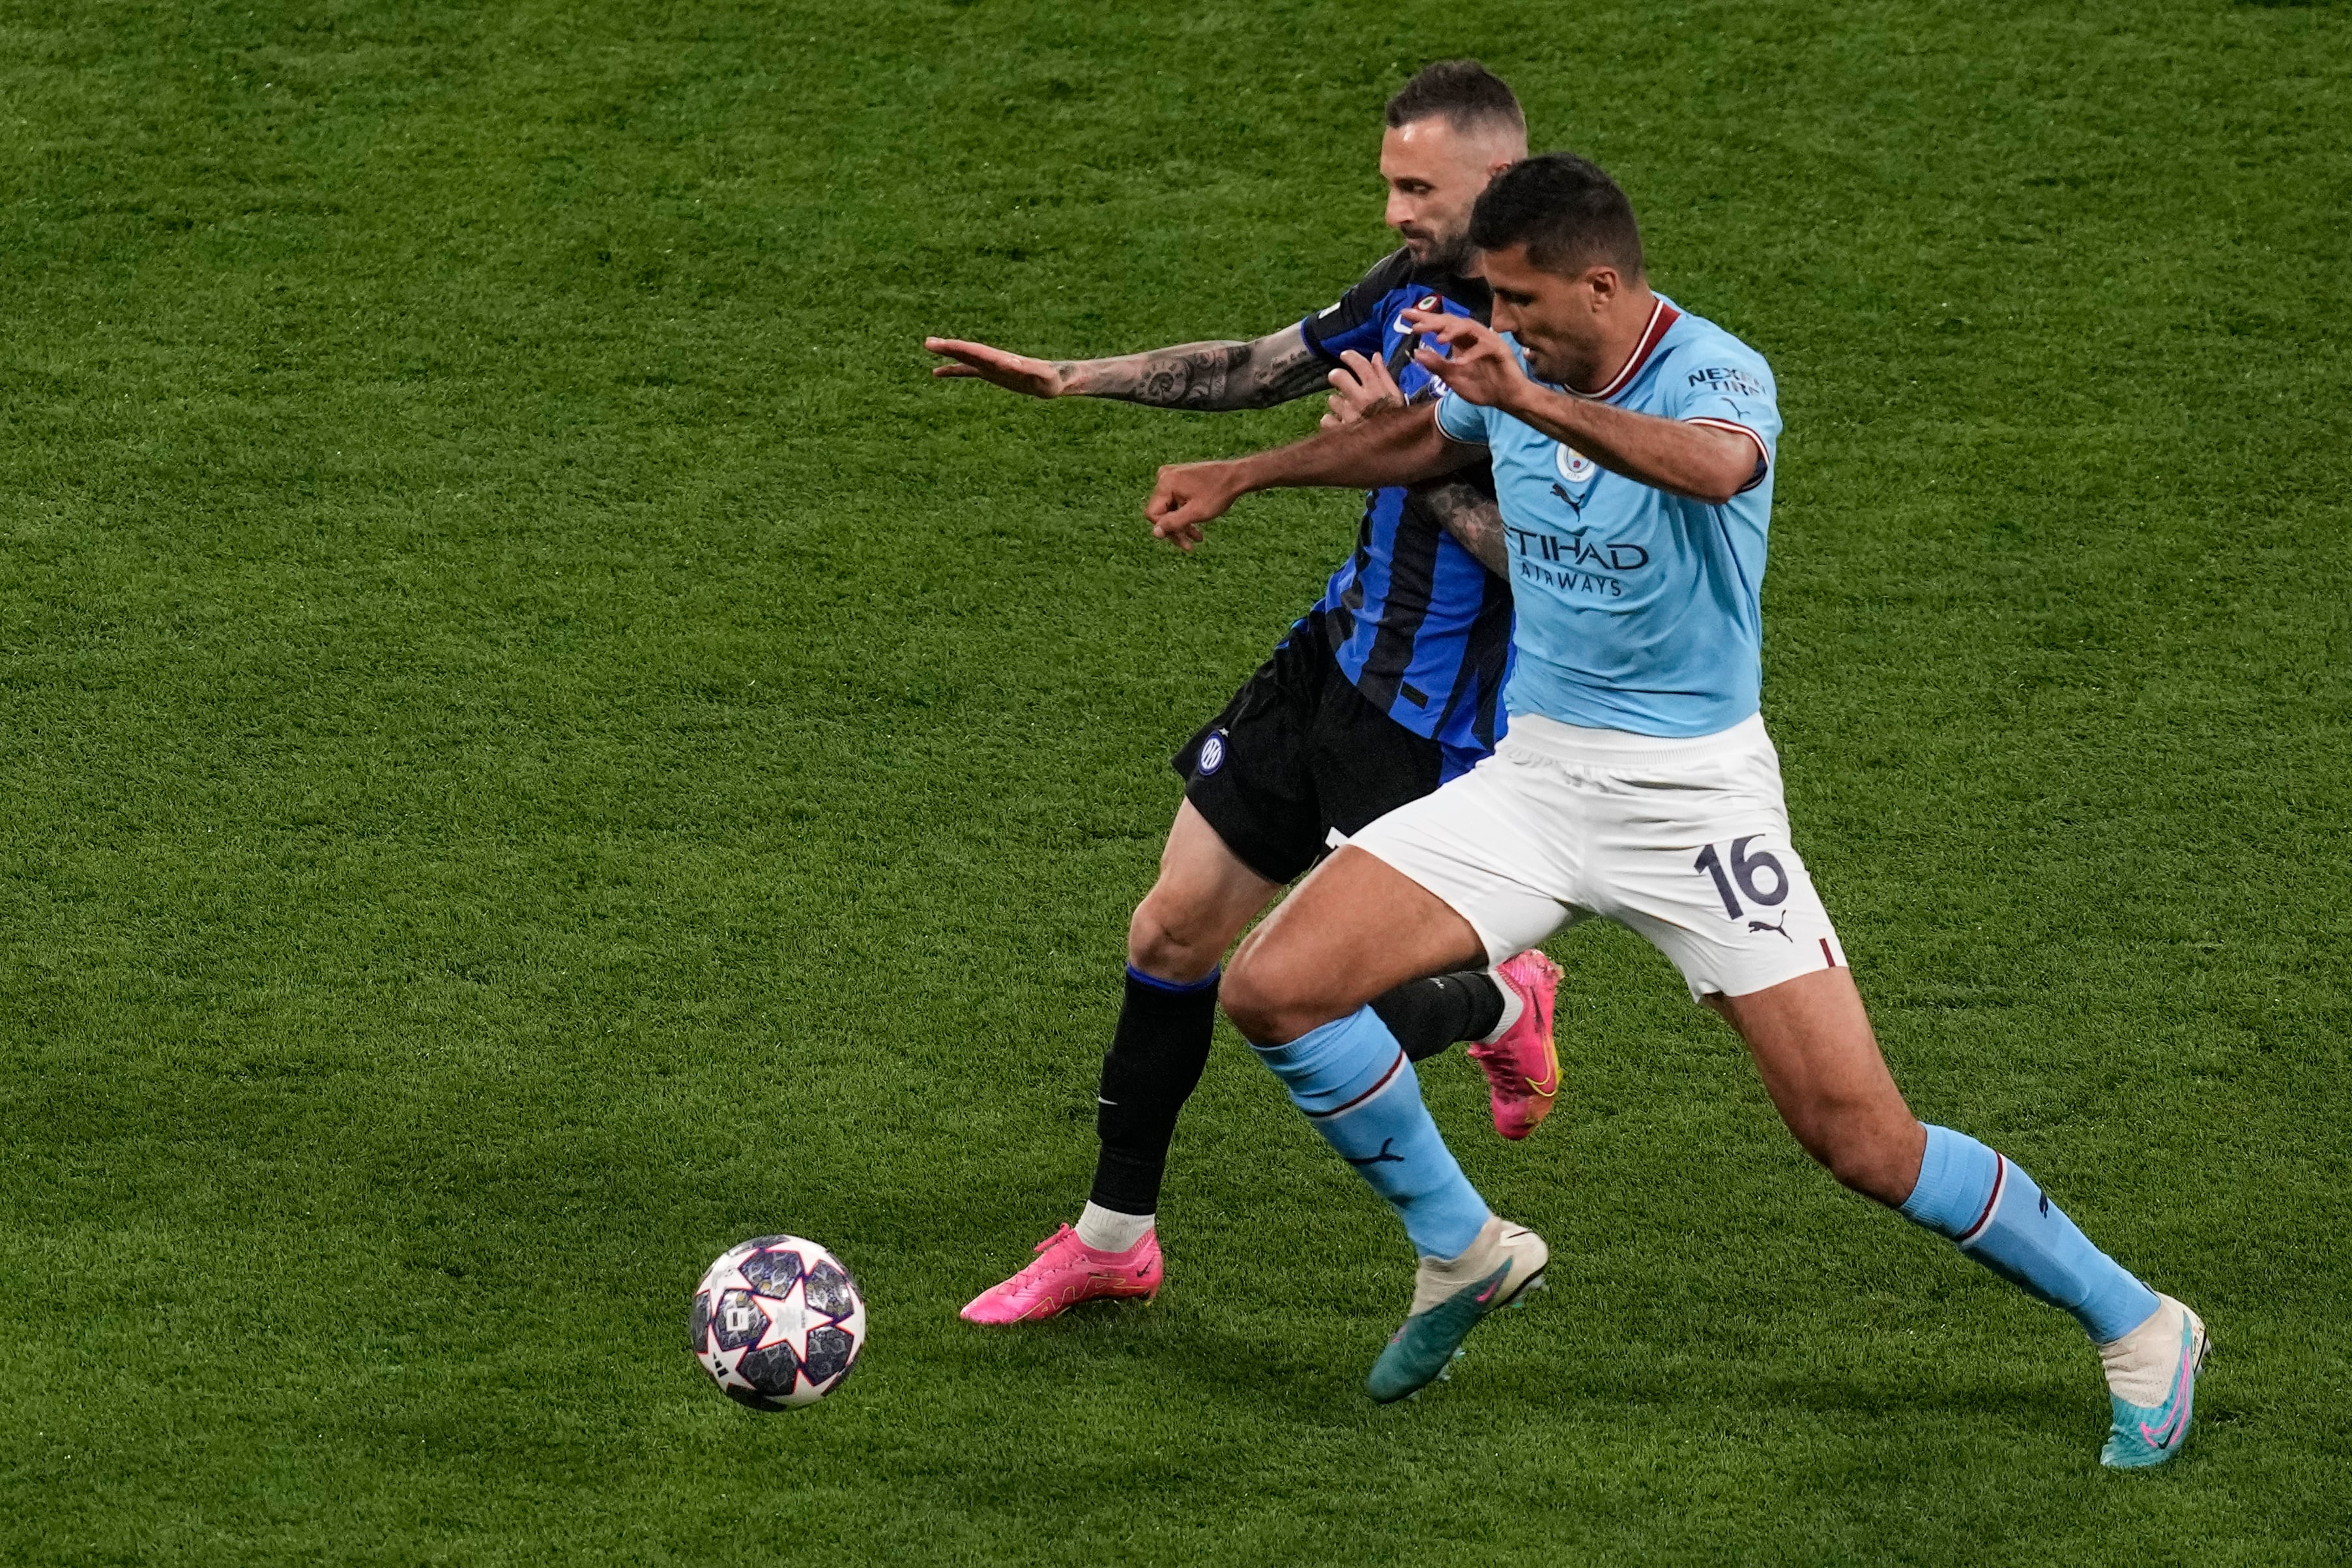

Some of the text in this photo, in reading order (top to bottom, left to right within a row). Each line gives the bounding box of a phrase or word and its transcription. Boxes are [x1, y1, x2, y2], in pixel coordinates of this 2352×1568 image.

[1503, 520, 1649, 570] TIHAD
[1521, 561, 1622, 596] AIRWAYS
[1694, 834, 1788, 920] 16
